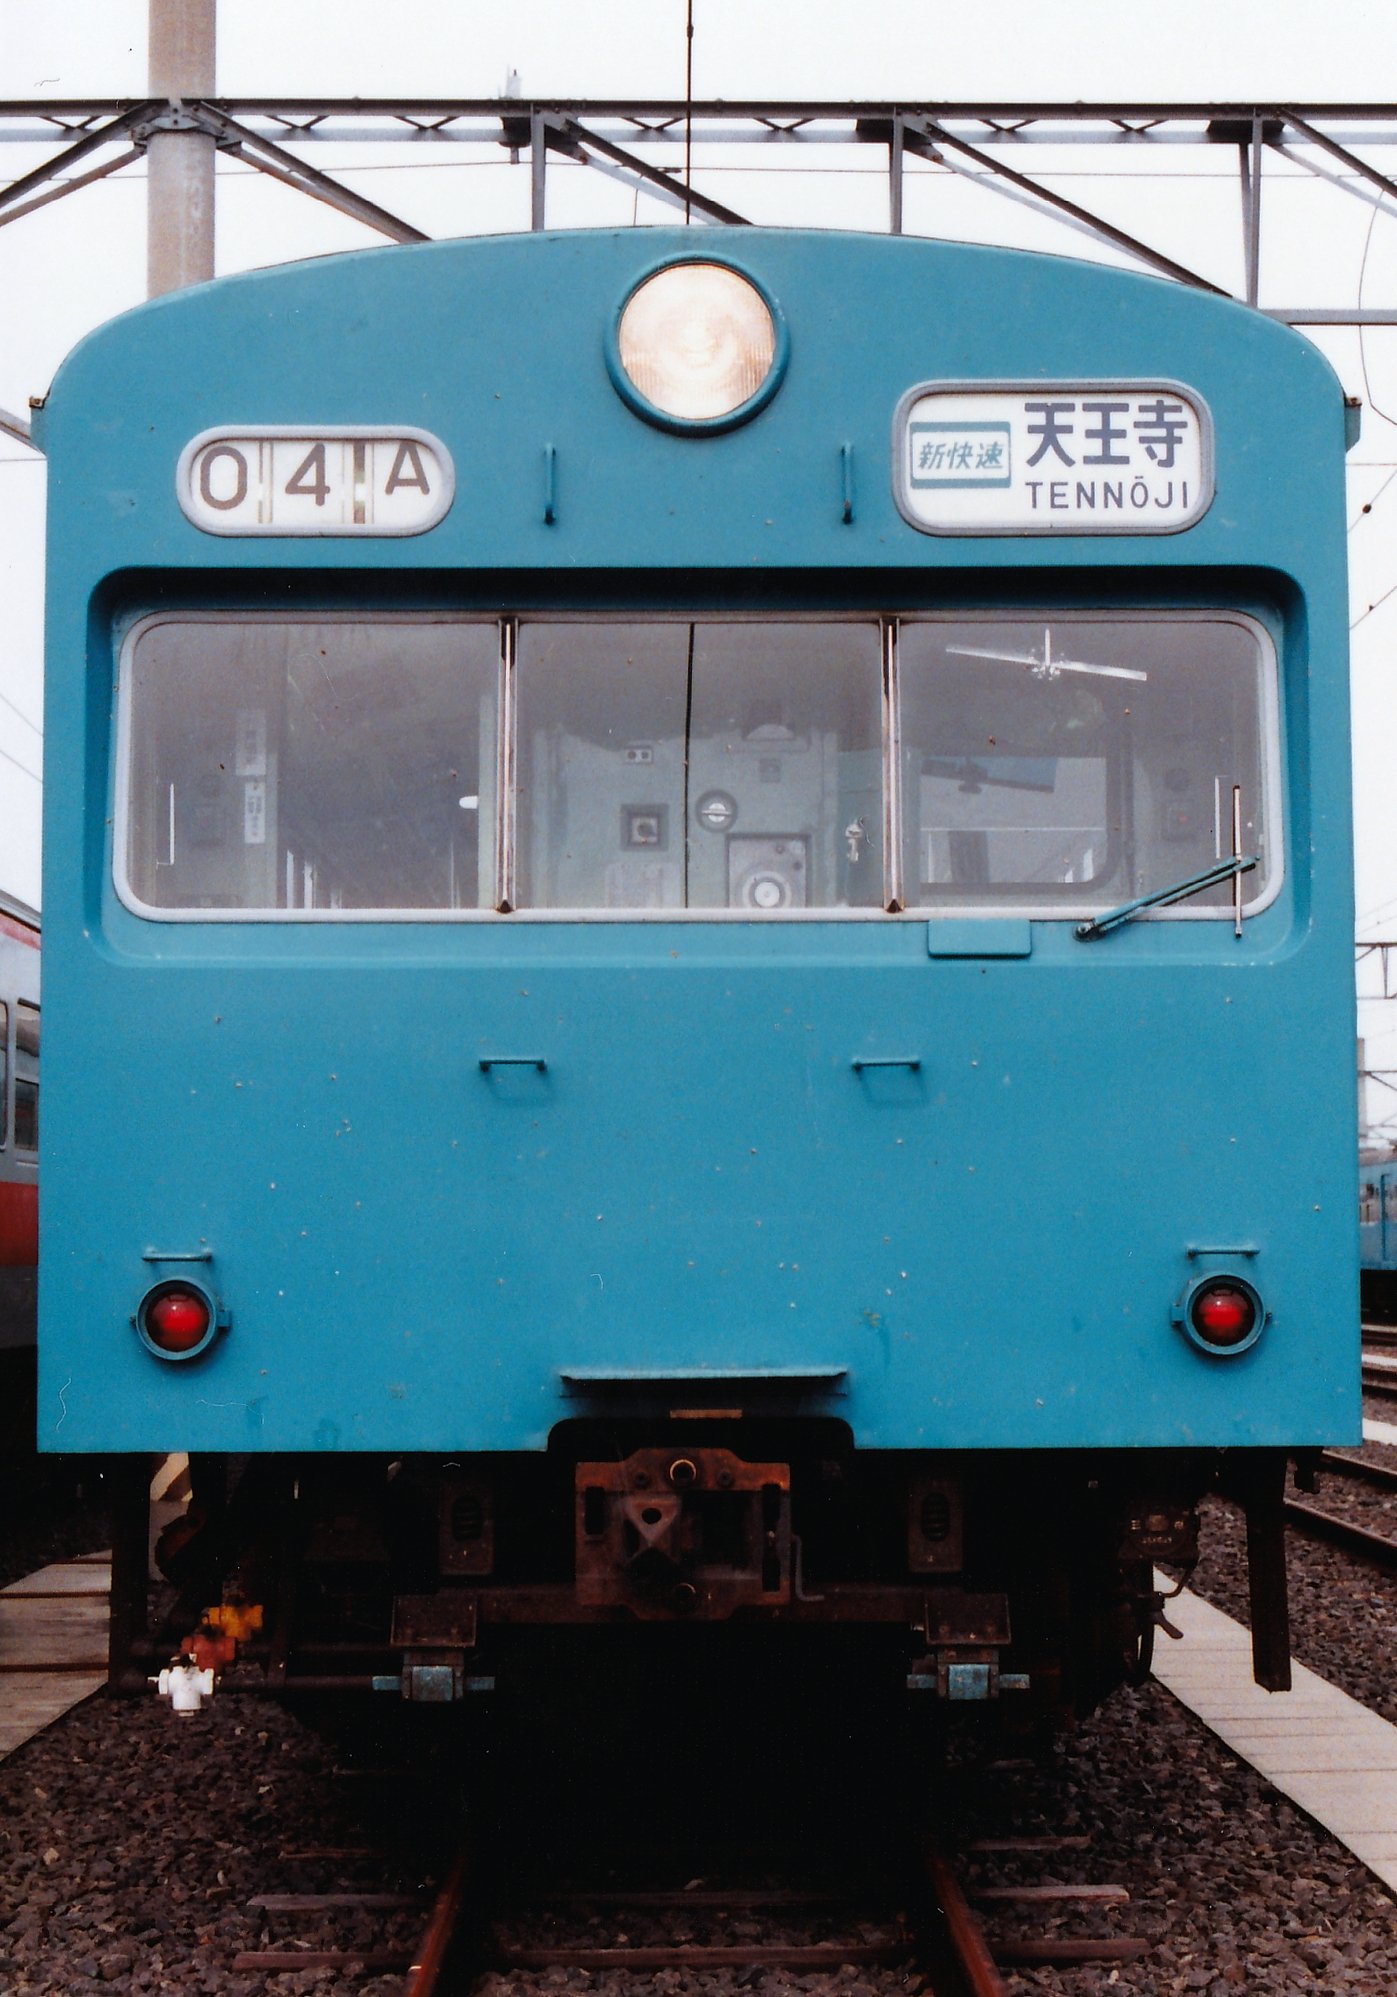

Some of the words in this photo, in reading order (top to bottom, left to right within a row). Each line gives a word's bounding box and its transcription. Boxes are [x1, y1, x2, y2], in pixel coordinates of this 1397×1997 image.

[918, 440, 1004, 470] 新快速
[1024, 400, 1188, 468] 天王寺
